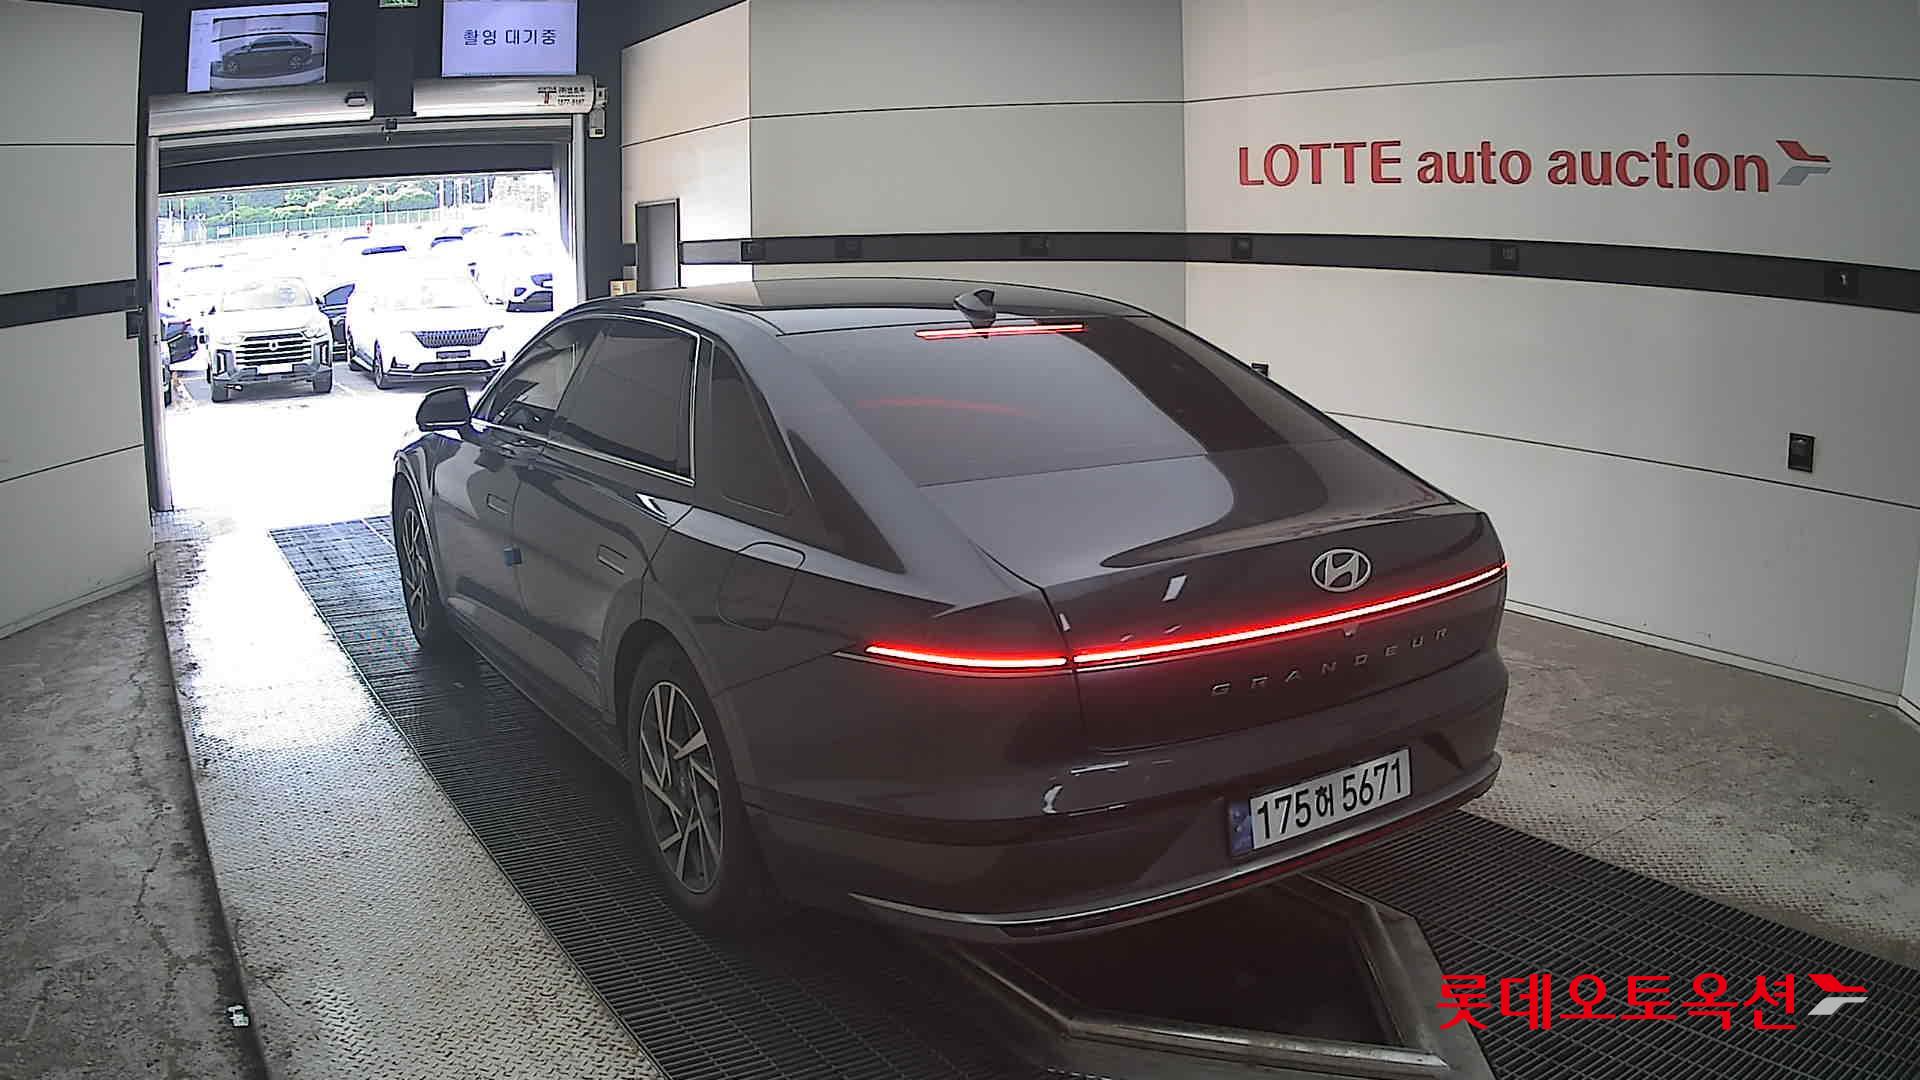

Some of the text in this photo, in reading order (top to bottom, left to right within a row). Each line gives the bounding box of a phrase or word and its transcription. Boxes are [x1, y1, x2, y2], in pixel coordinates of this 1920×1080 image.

[464, 29, 556, 45] 촬영 대기중
[1238, 132, 1770, 193] LOTTE auto auction
[1210, 628, 1450, 696] GRANDEUR
